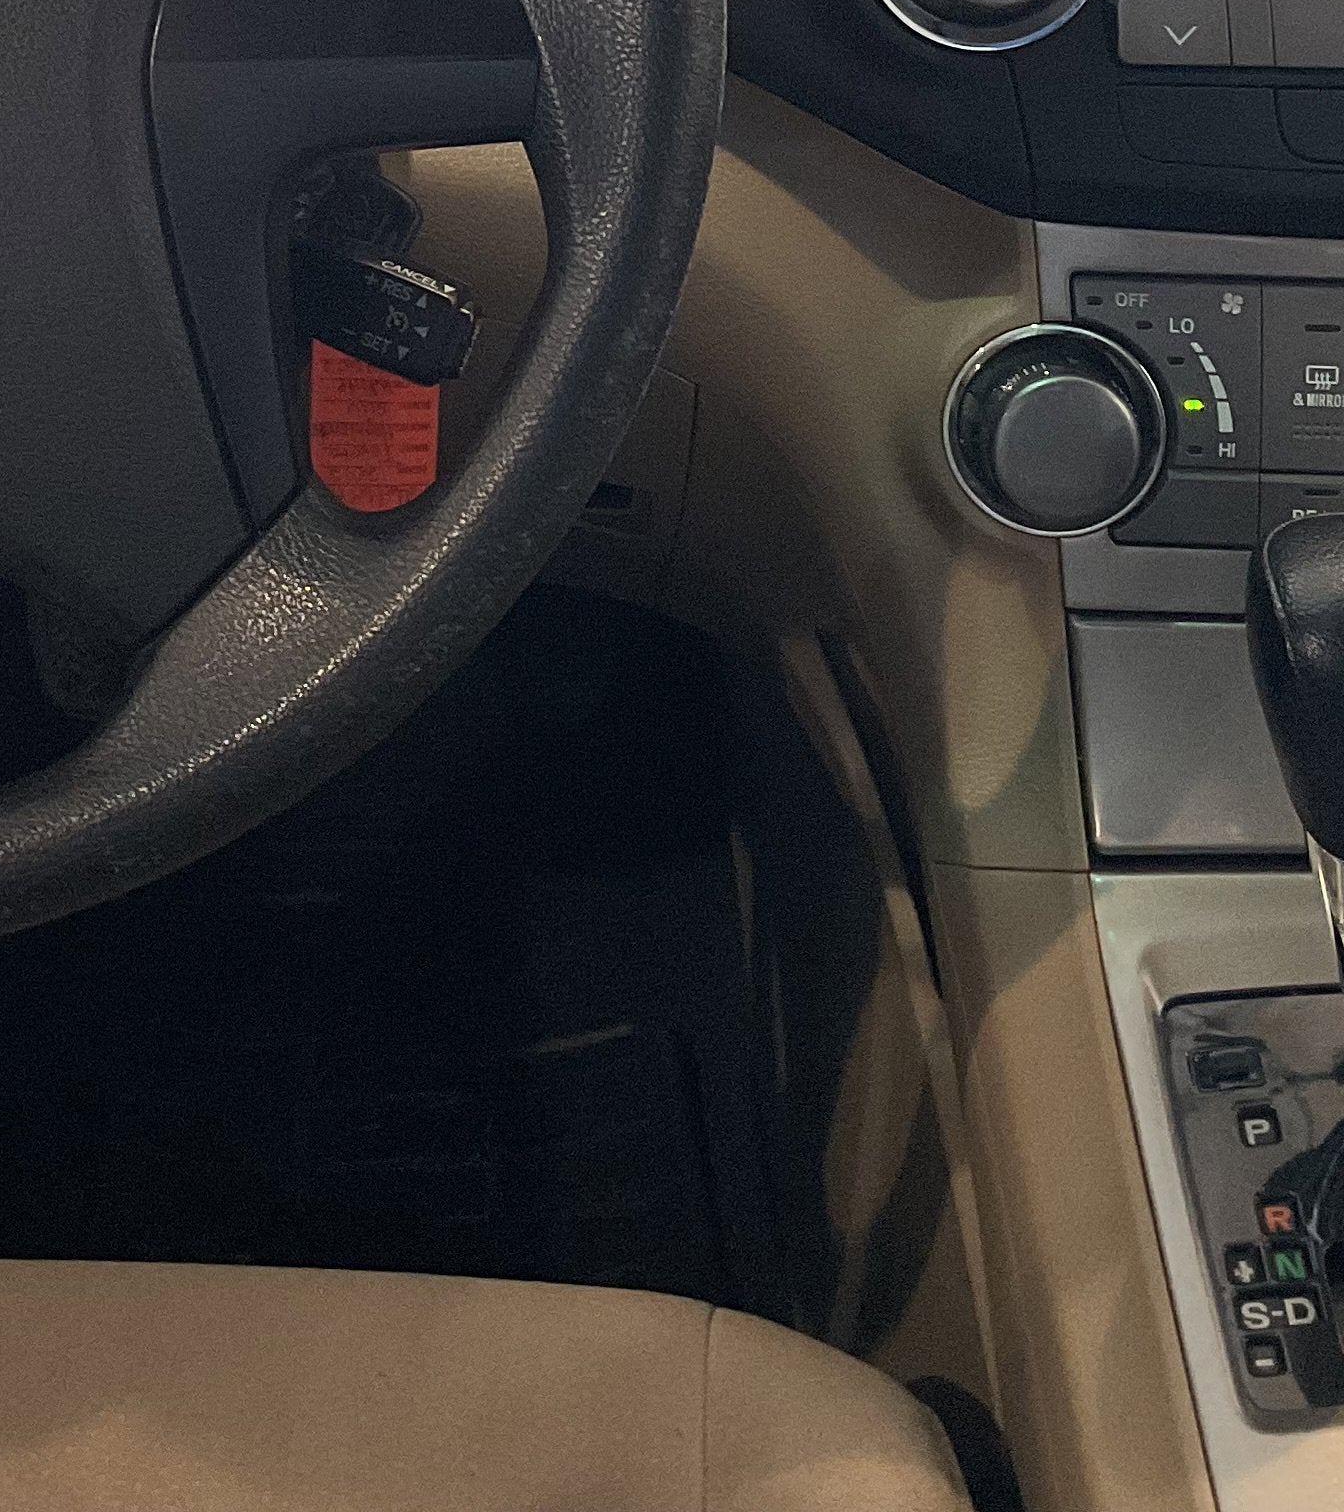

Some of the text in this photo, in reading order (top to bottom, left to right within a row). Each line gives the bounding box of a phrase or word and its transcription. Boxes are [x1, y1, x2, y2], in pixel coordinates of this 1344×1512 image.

[381, 260, 439, 290] CANCEL
[1115, 292, 1150, 307] OFF
[1168, 317, 1195, 334] LO
[1292, 393, 1304, 407] &
[1218, 442, 1236, 458] HI
[1244, 1118, 1270, 1145] P
[1264, 1205, 1292, 1232] R
[1273, 1250, 1306, 1279] N
